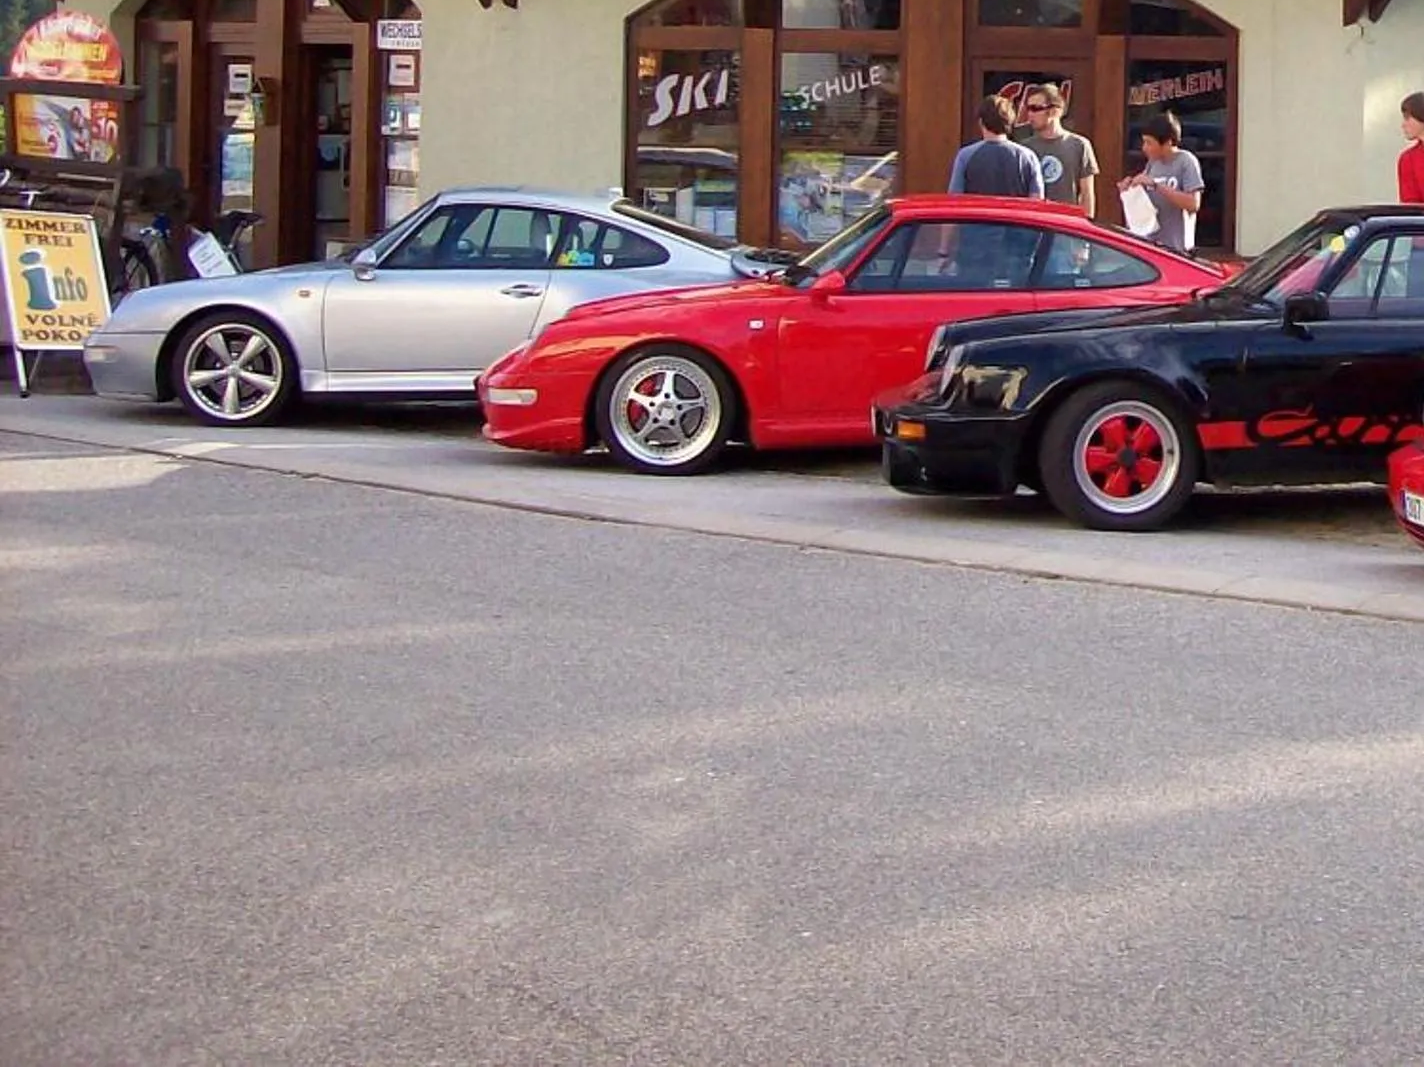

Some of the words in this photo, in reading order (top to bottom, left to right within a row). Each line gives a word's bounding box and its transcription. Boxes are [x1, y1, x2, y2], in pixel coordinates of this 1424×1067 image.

[647, 69, 729, 126] SKI
[800, 65, 884, 105] SCHULE
[1128, 68, 1224, 105] VERLEIH
[6, 218, 86, 233] ZIMMER
[24, 233, 74, 247] FREI
[19, 251, 88, 310] info
[26, 313, 102, 327] VOLNÉ
